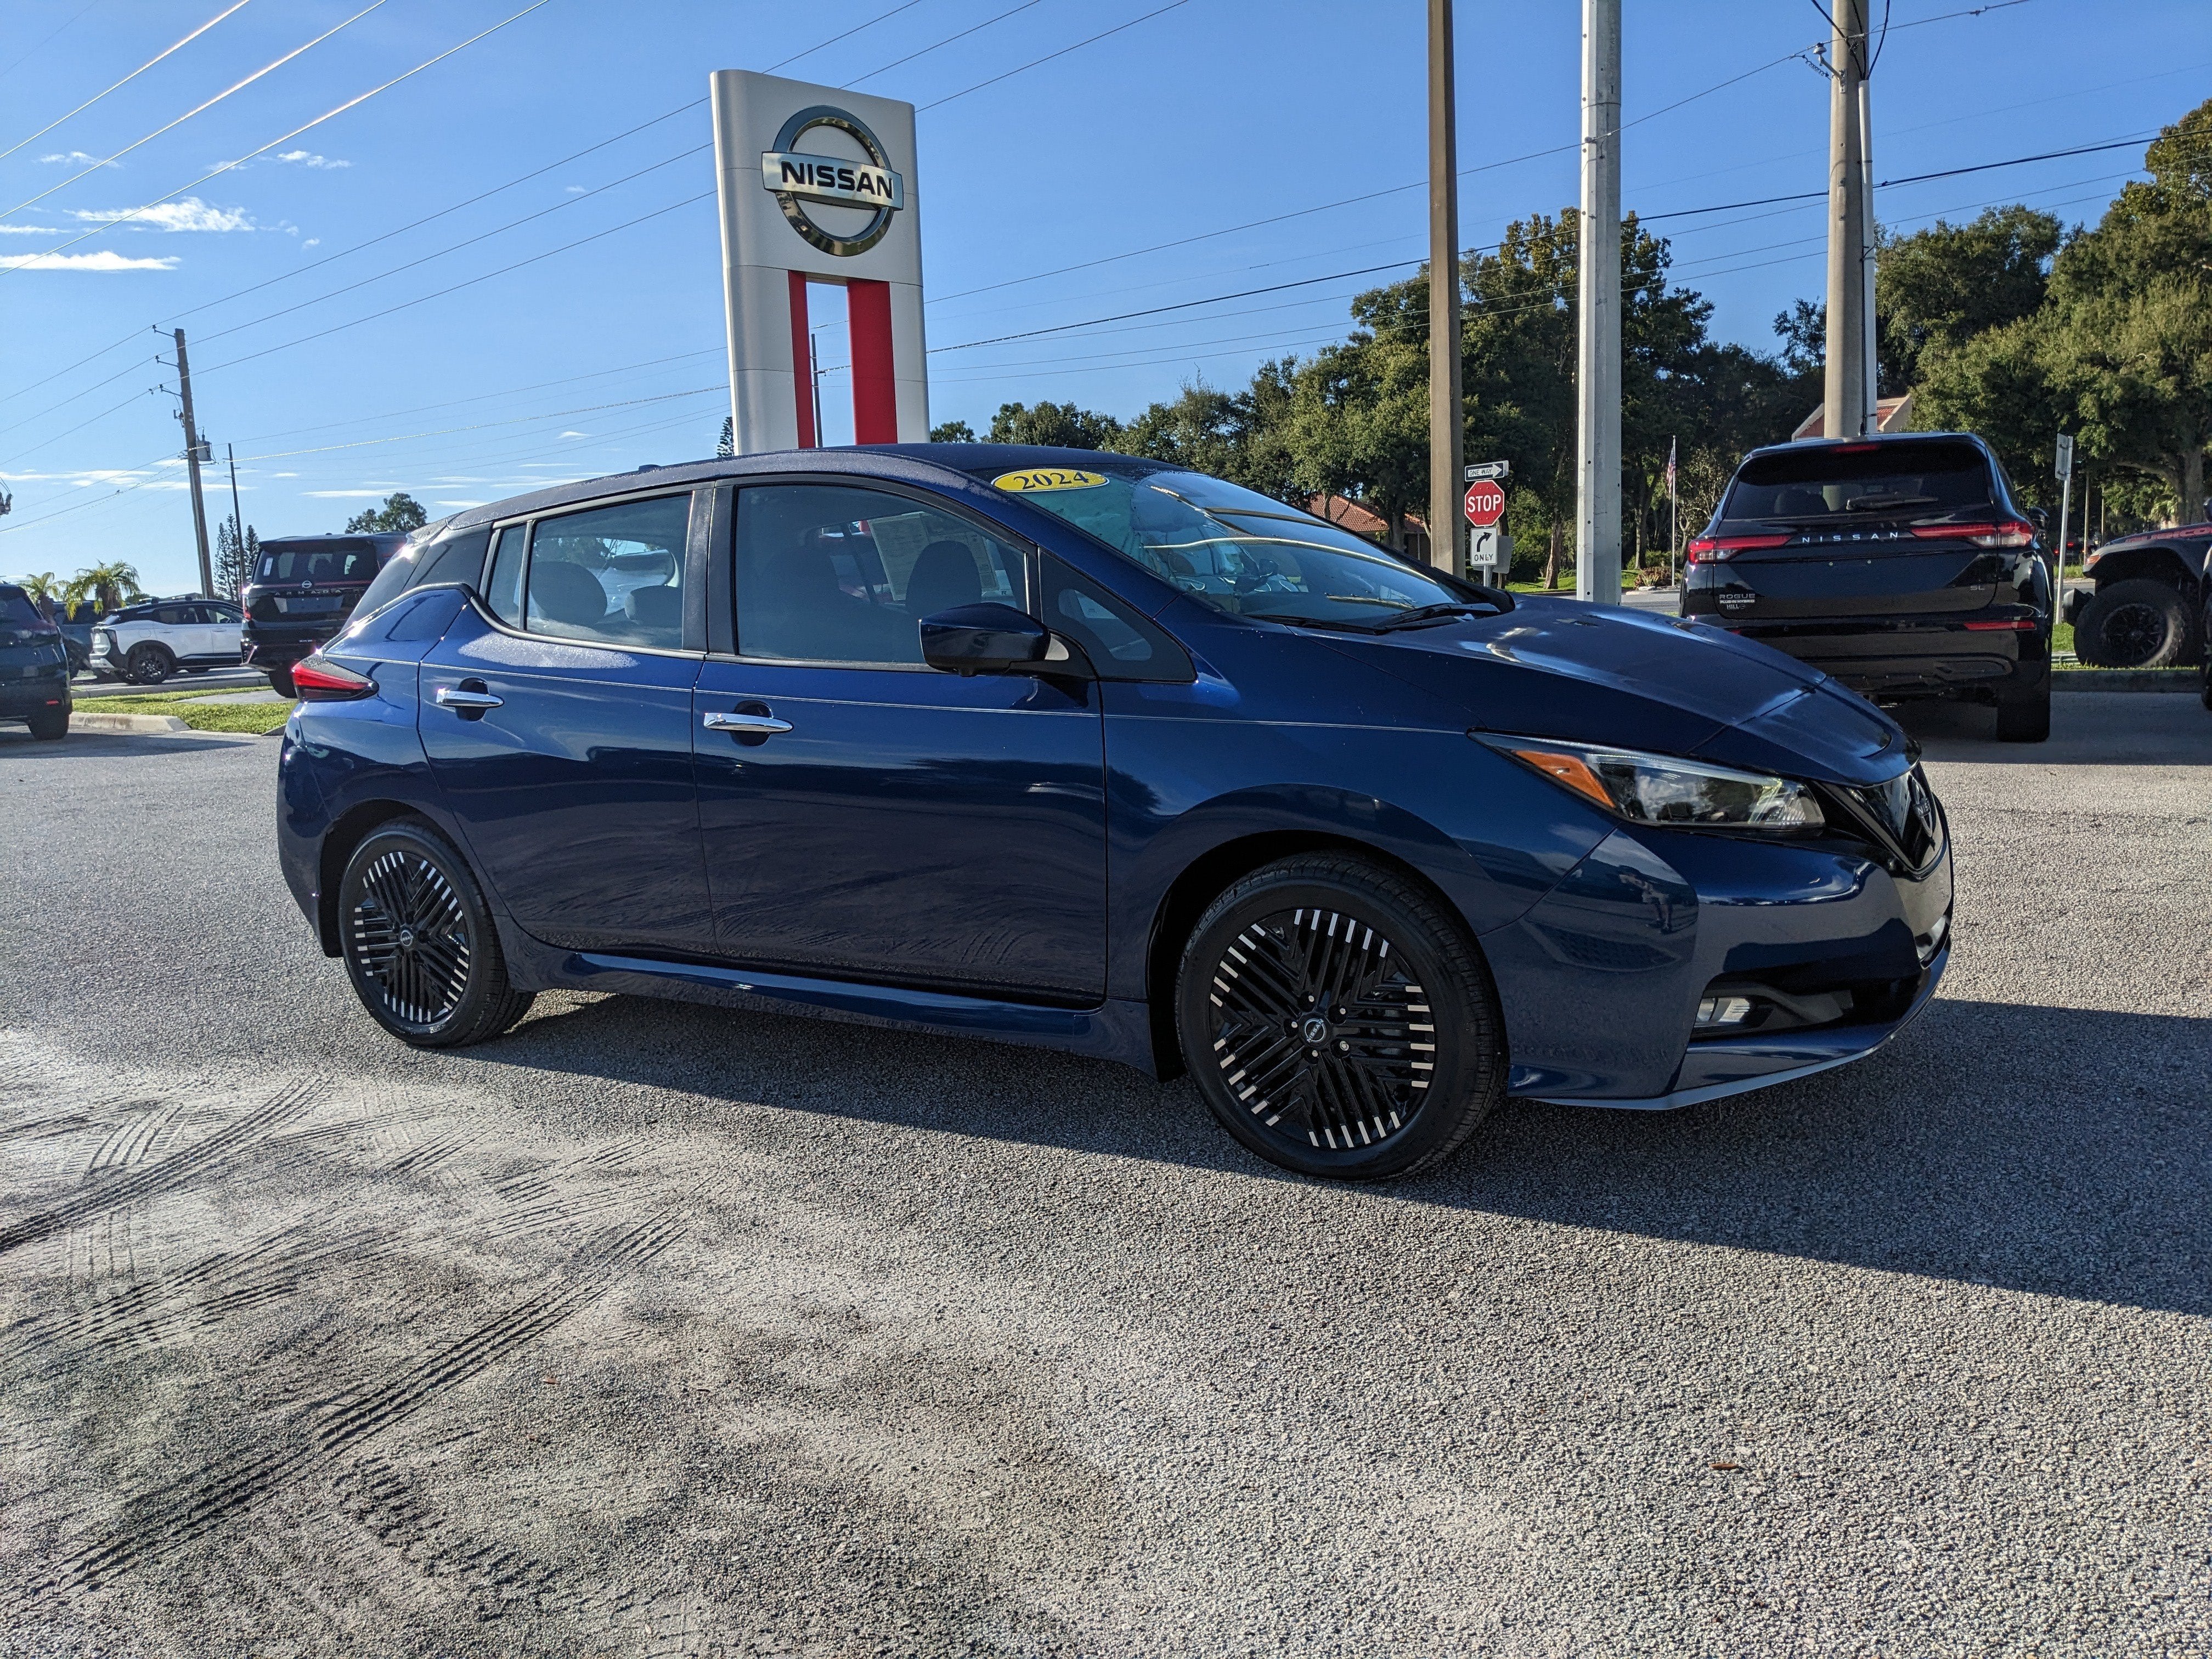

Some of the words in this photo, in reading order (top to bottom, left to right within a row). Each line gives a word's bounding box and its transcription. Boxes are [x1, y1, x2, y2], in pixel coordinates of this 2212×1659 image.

[781, 161, 894, 200] NISSAN
[1014, 472, 1089, 490] 2024
[1467, 494, 1502, 513] STOP
[1802, 532, 1898, 544] NISSAN
